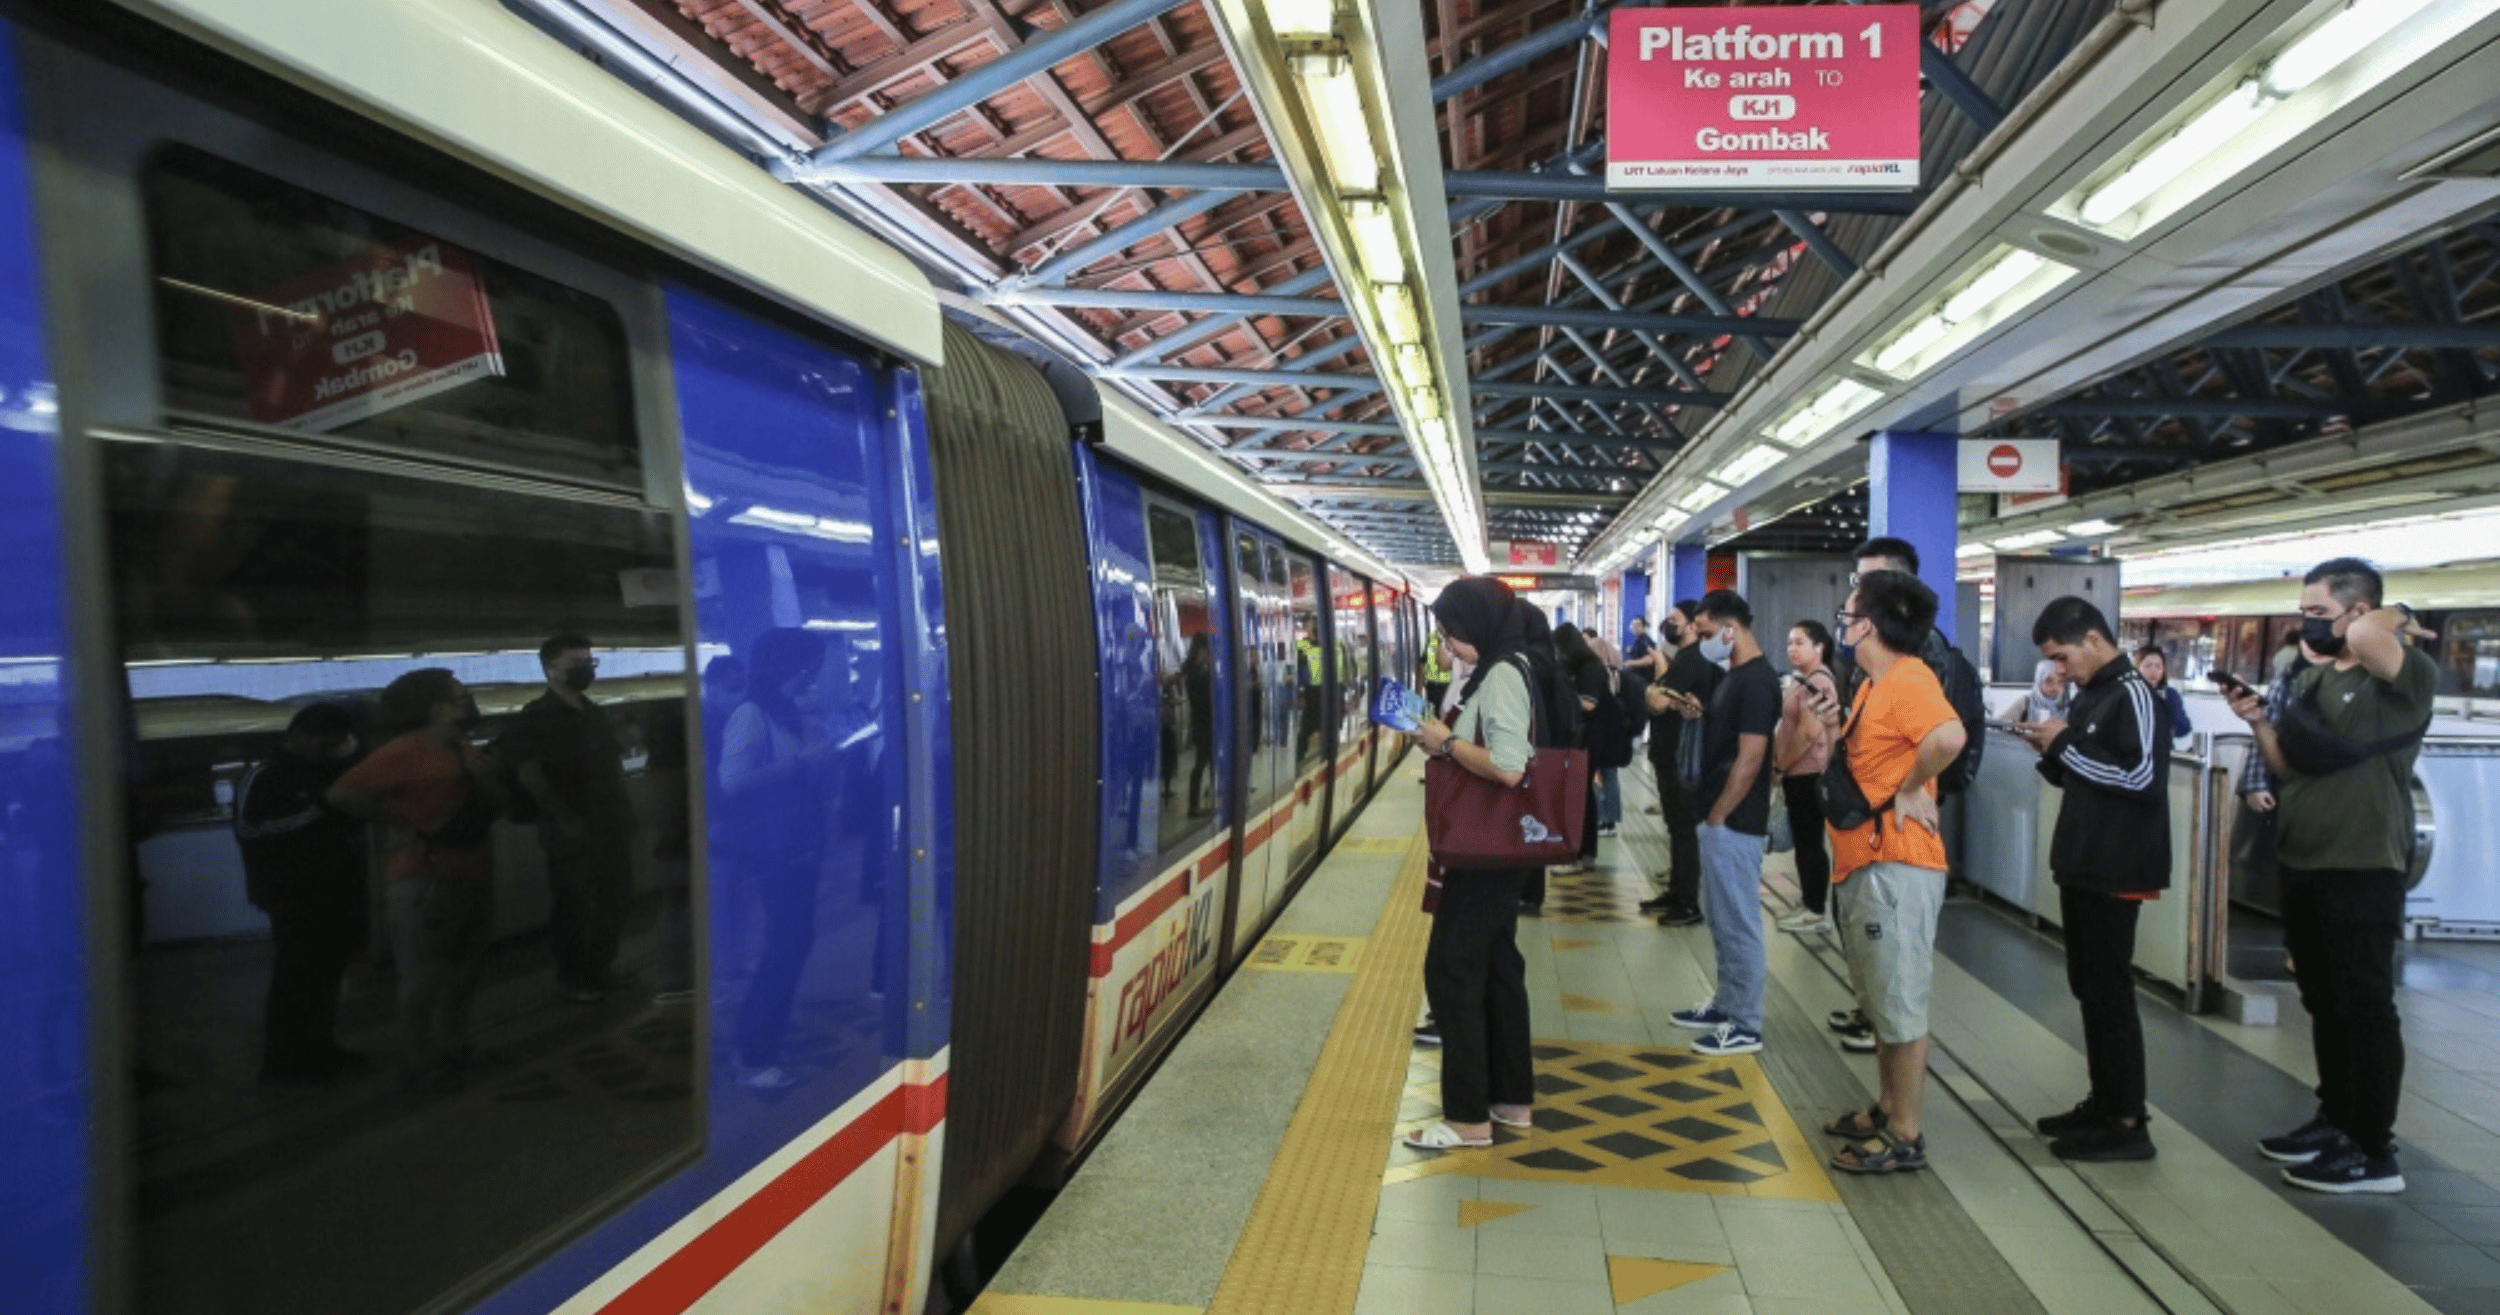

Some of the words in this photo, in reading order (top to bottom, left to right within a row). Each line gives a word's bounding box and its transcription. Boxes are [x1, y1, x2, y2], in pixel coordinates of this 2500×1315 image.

[1639, 25, 1844, 61] Platform
[1859, 22, 1882, 58] 1
[1684, 68, 1721, 89] Ke
[1729, 67, 1791, 89] arah
[1815, 70, 1843, 87] TO
[1742, 99, 1781, 117] KJ1
[1695, 127, 1830, 152] Gombak
[1110, 887, 1213, 1056] rapidKL
